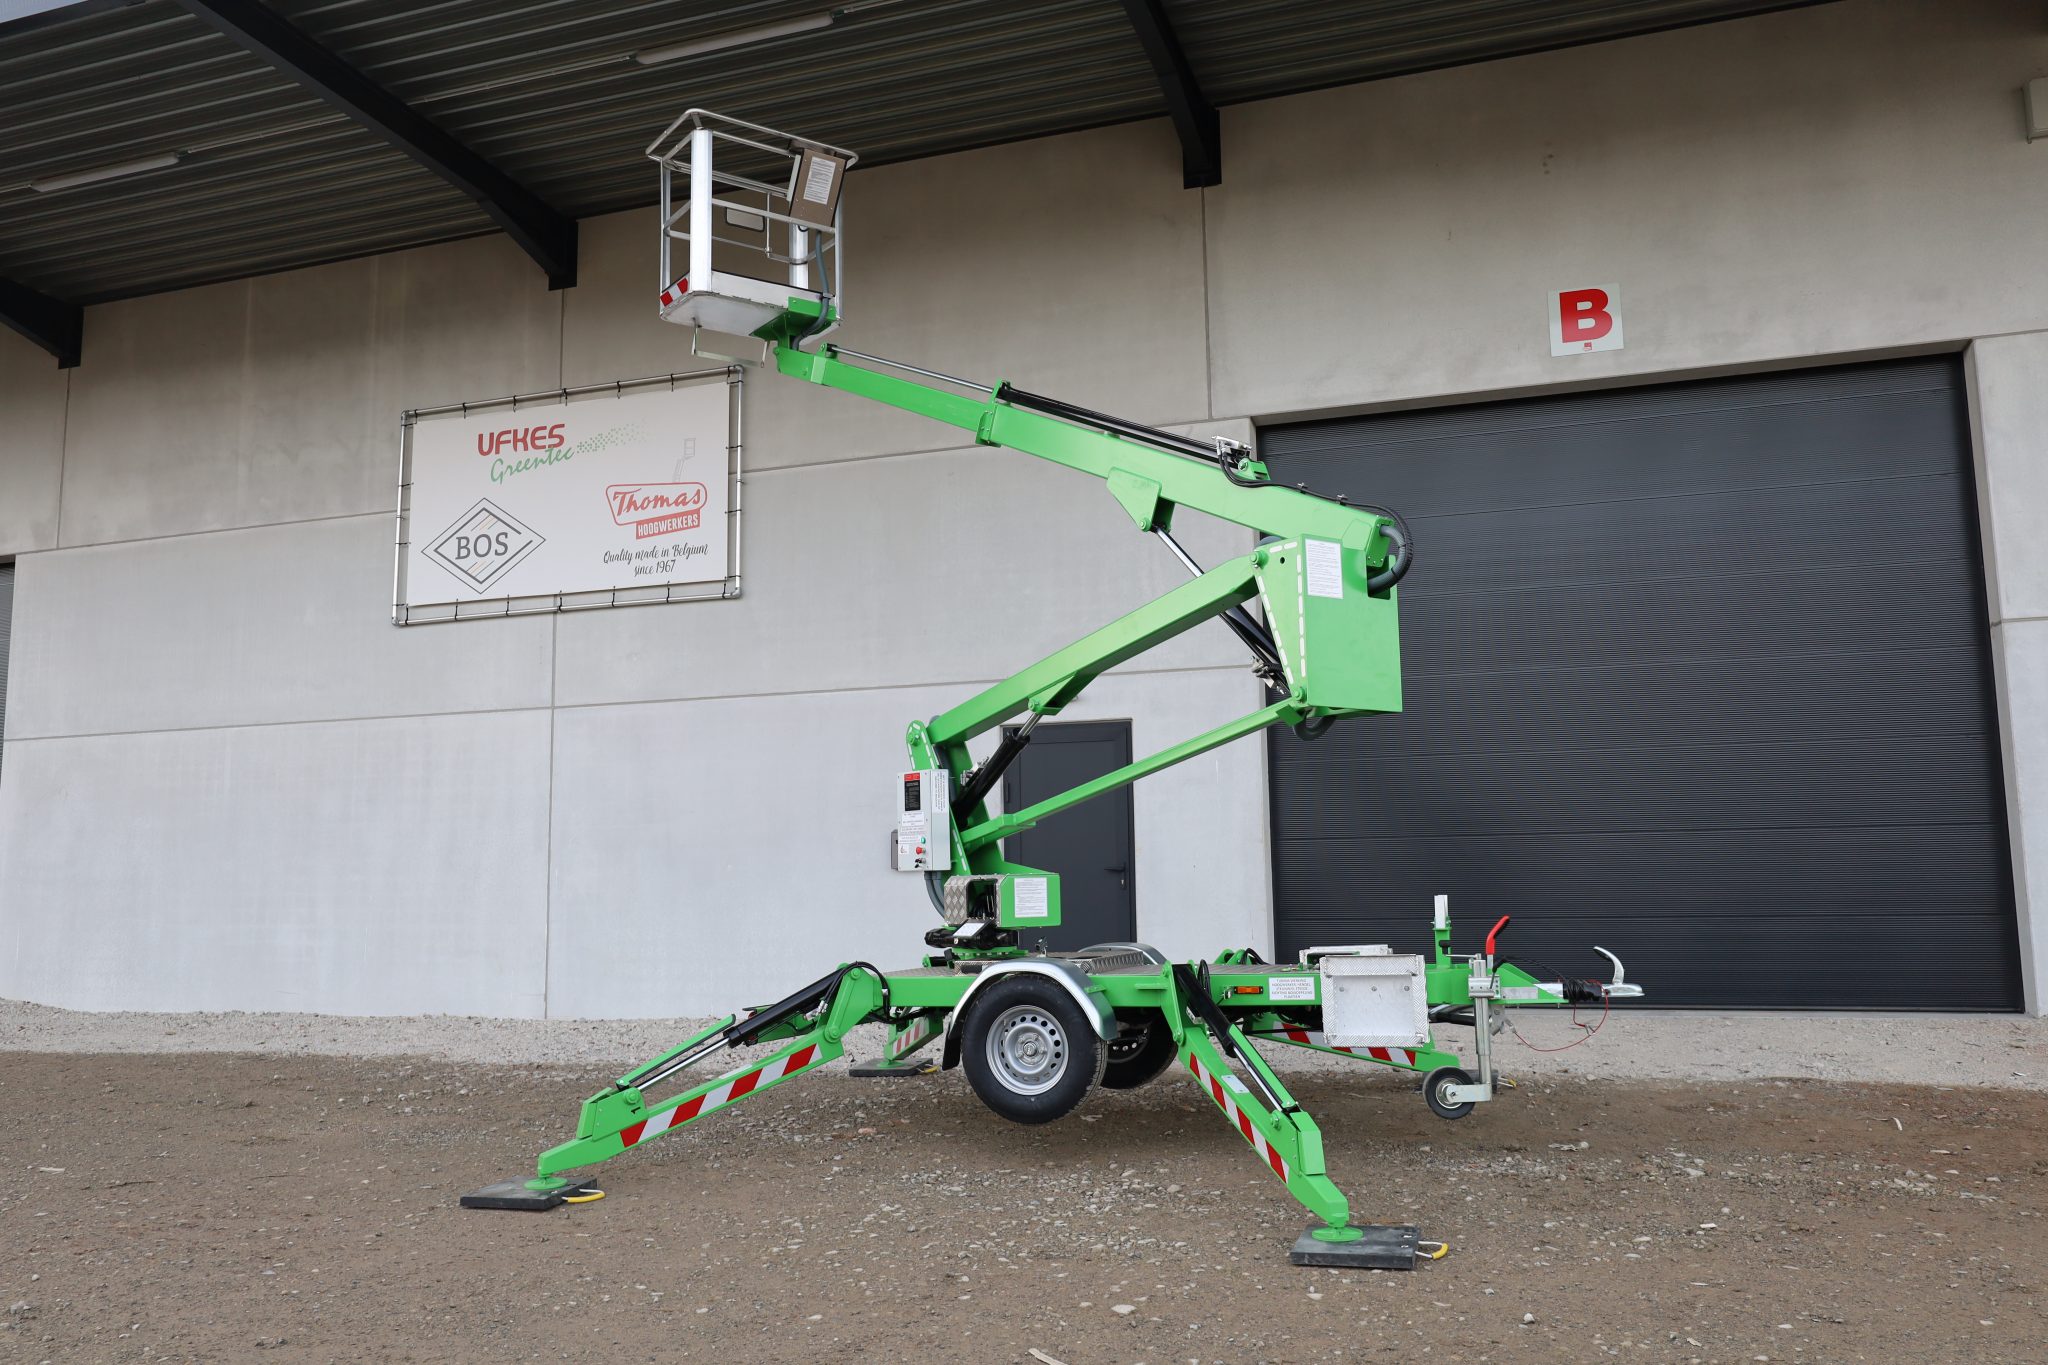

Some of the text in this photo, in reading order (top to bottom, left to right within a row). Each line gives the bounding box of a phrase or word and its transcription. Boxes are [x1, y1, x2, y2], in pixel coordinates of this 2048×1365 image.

[1559, 288, 1613, 343] B
[477, 423, 565, 456] UFKES
[490, 447, 575, 484] Greentec
[613, 488, 701, 516] Thomas
[637, 513, 699, 537] HOOGWERKERS
[455, 531, 509, 560] BOS
[603, 542, 709, 565] Quality made in Belgium
[634, 559, 677, 577] since 1967
[630, 1106, 641, 1115] 1
